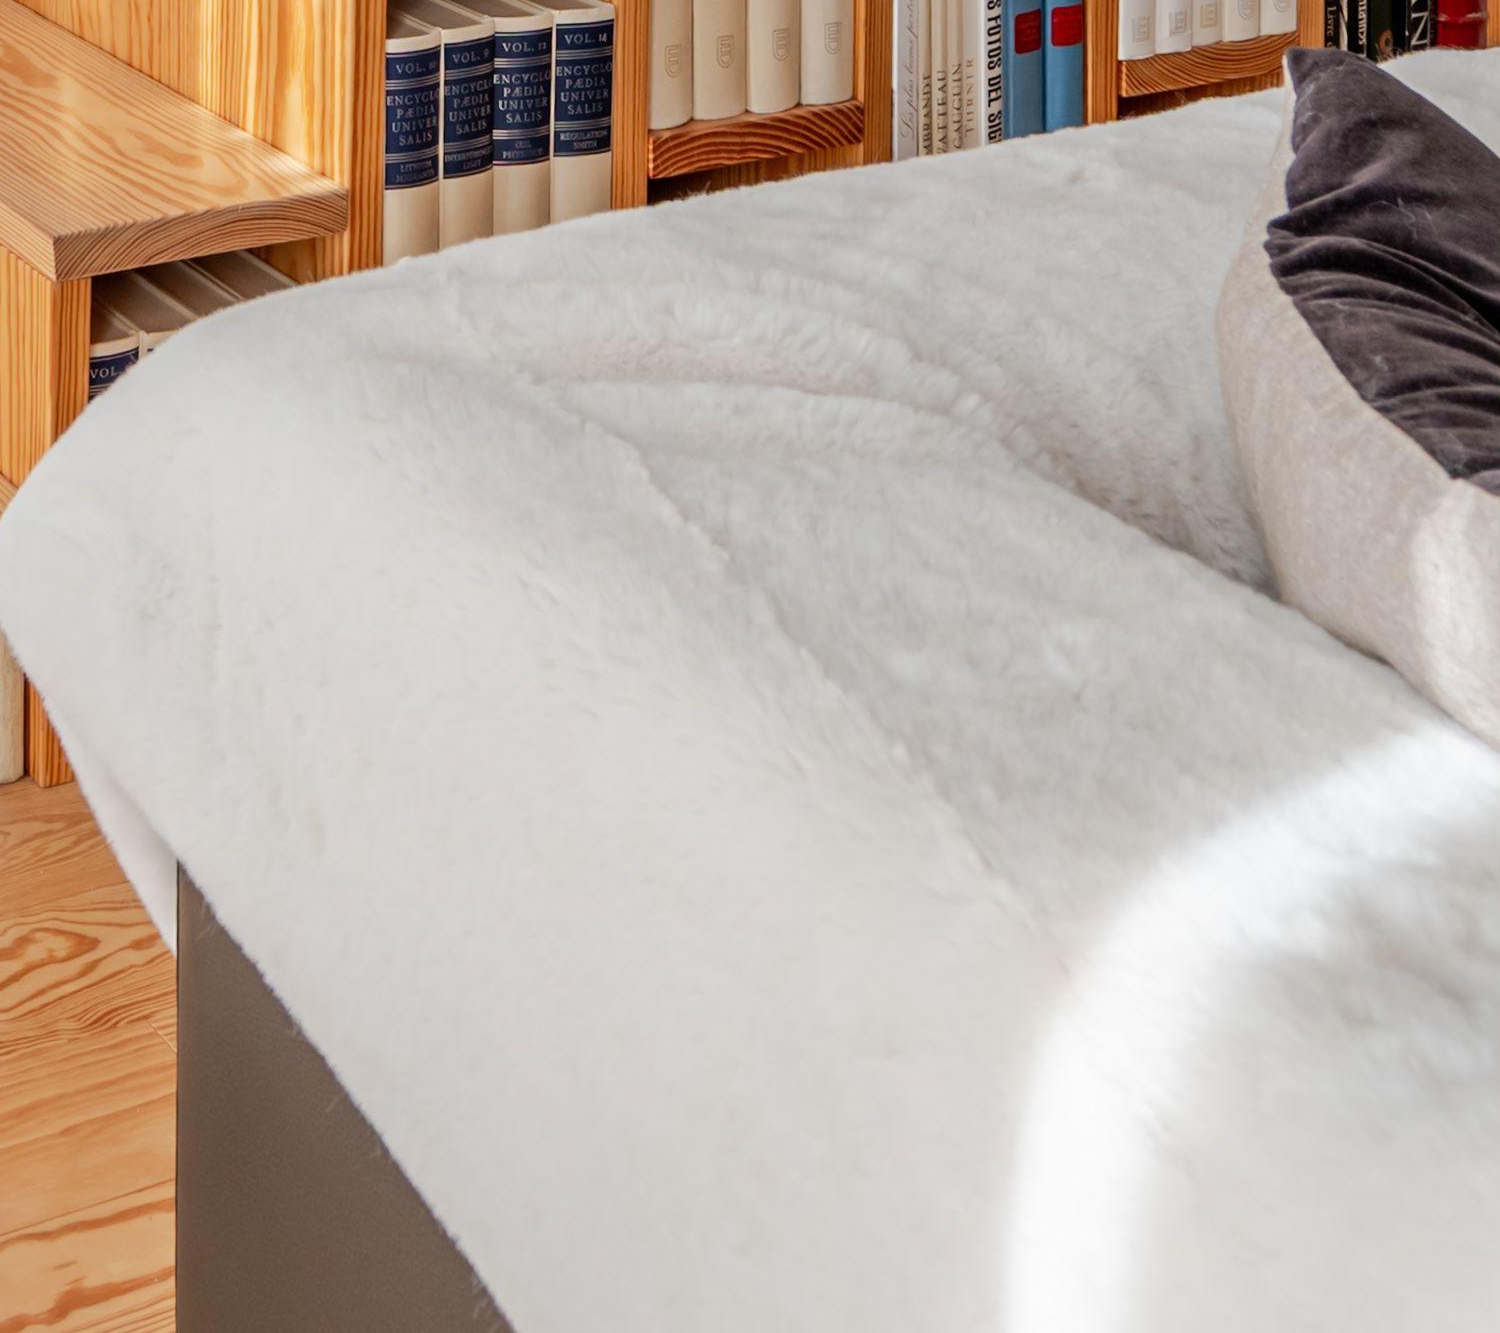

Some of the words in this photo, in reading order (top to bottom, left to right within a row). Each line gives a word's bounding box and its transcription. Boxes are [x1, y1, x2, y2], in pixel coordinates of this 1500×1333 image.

[1327, 7, 1337, 36] Livre
[565, 33, 595, 44] VOL.
[502, 41, 534, 52] VOL.
[453, 52, 480, 64] VOL.
[397, 63, 426, 74] VOL.
[556, 62, 613, 77] ENCYCLO
[561, 88, 609, 102] UNIVER
[988, 74, 1002, 108] DEL
[499, 98, 548, 111] UNIVER
[568, 103, 603, 115] SALIS
[952, 63, 963, 149] GAUGUIN
[506, 111, 542, 123] SALIS
[920, 74, 931, 155] MBRANDT
[937, 70, 947, 154] ATTEAU
[456, 121, 487, 134] SALIS
[399, 133, 432, 146] SALIS
